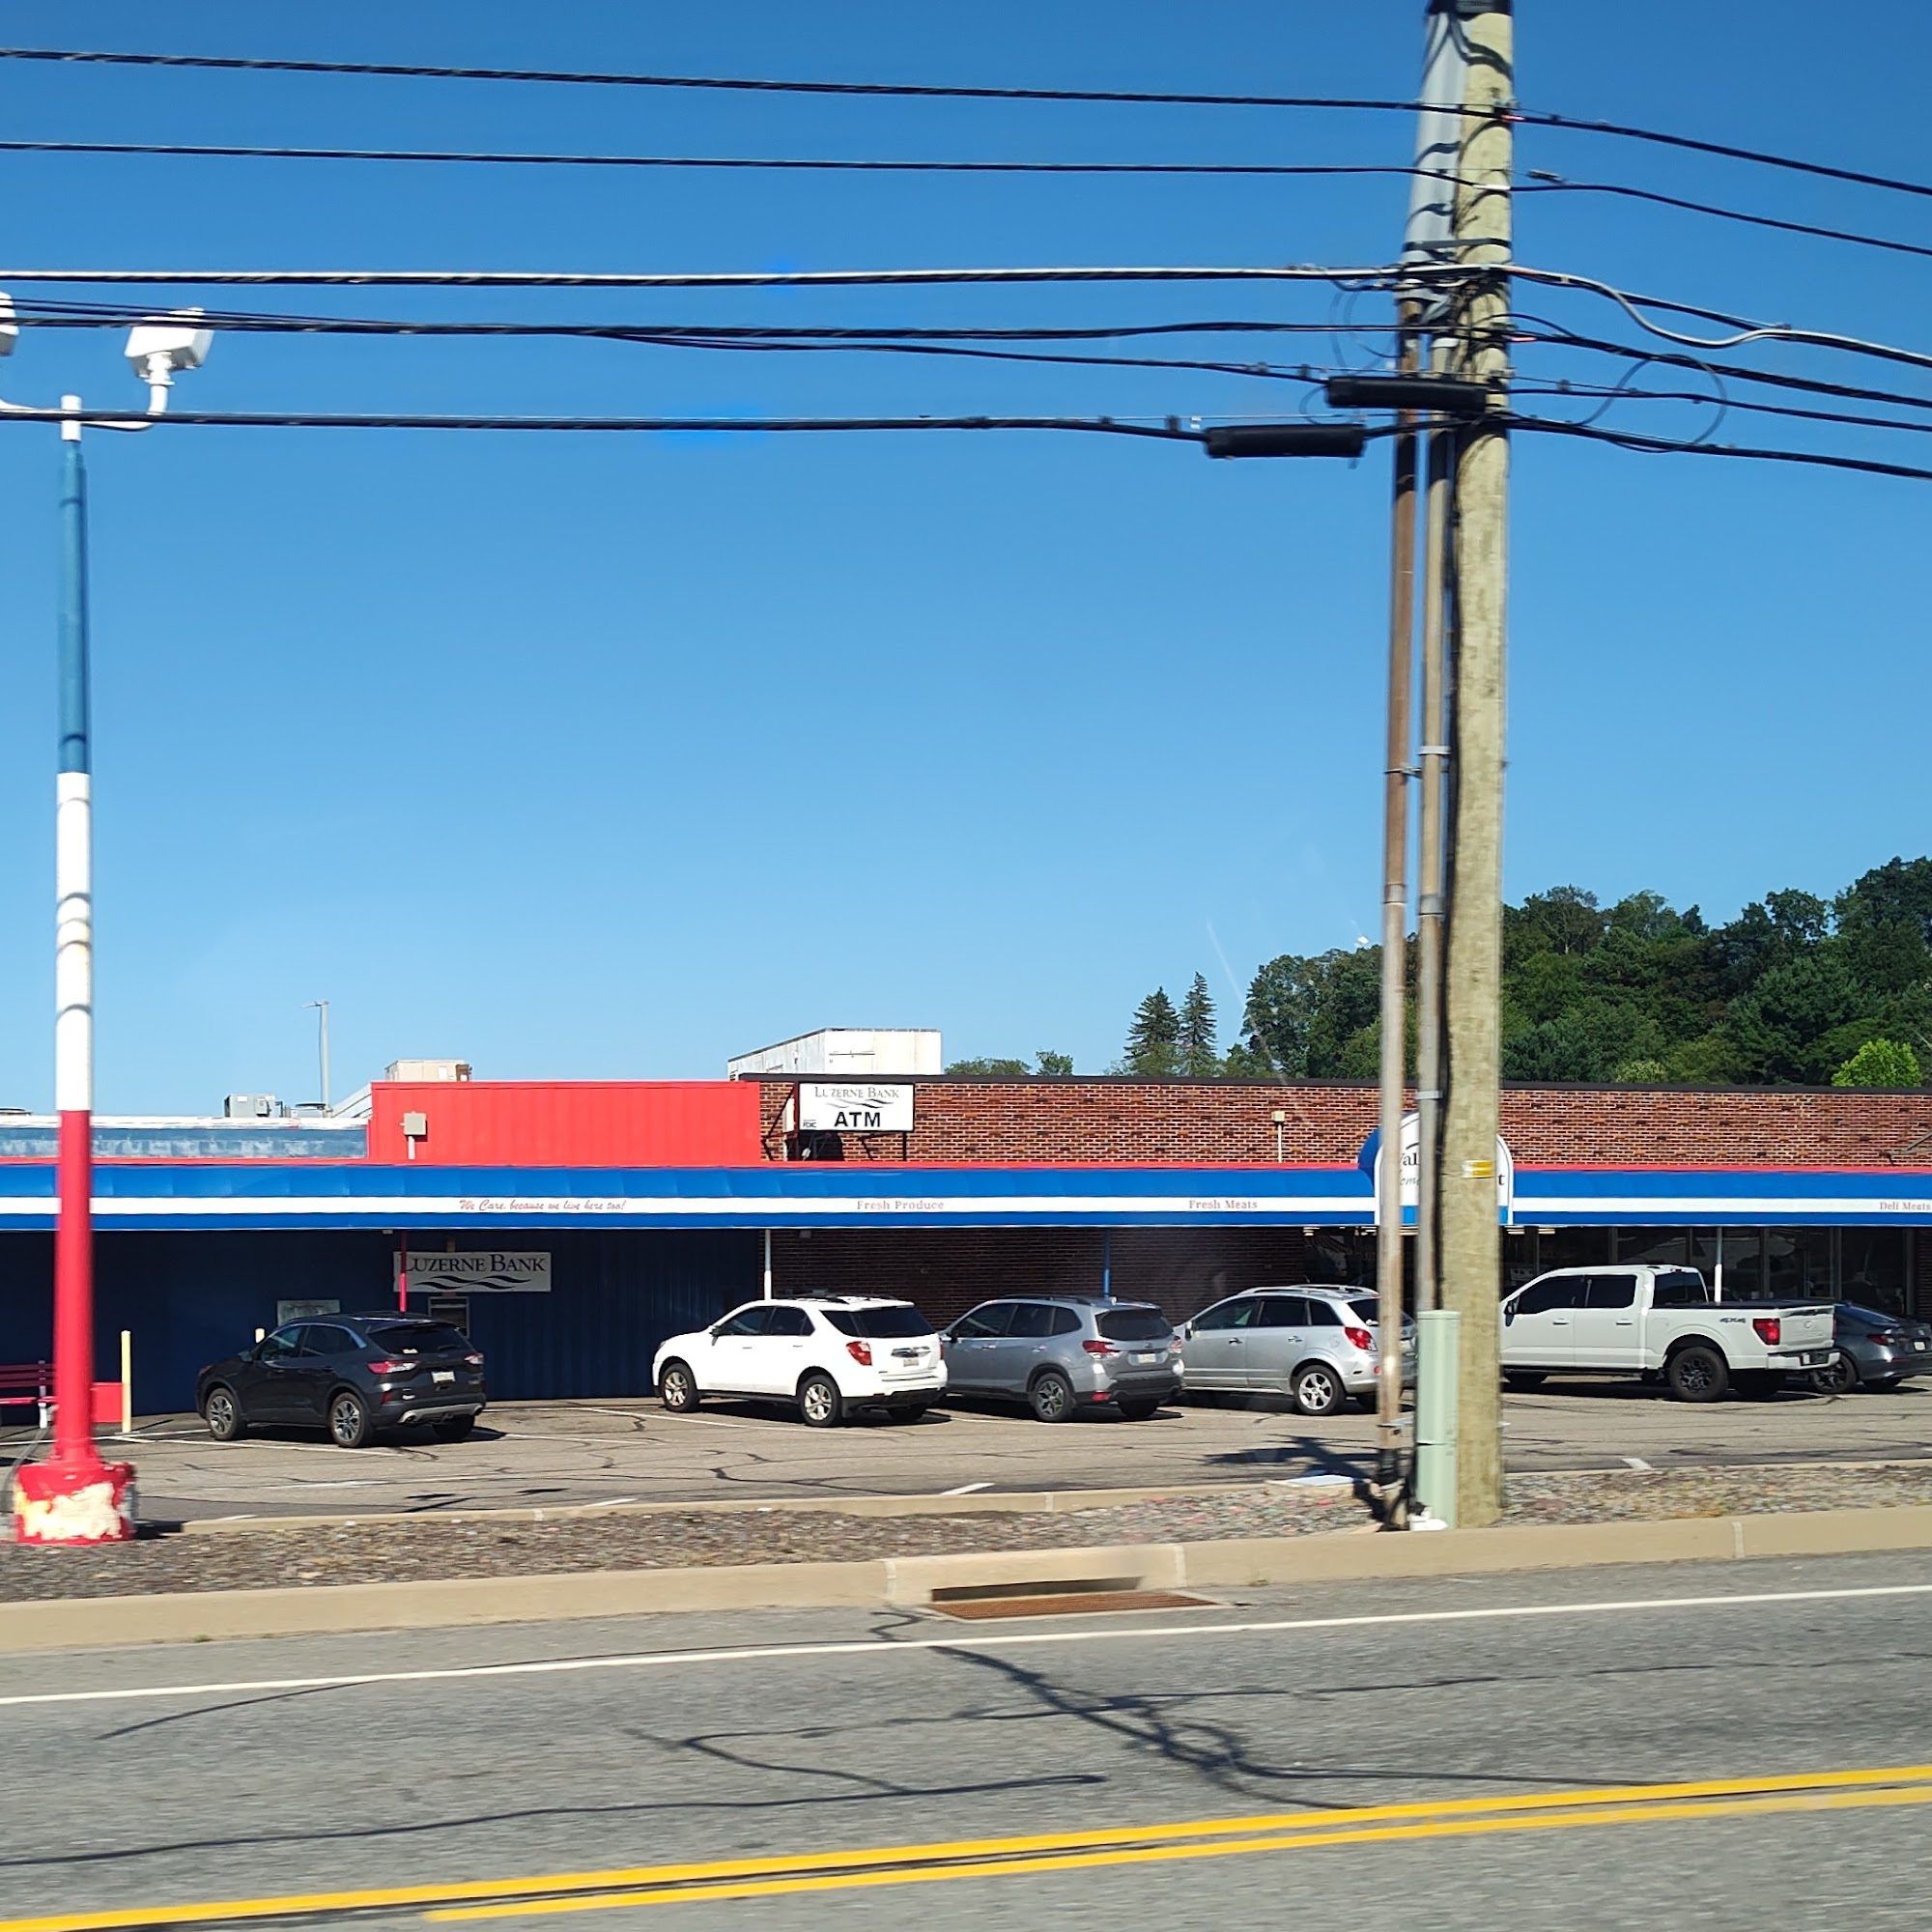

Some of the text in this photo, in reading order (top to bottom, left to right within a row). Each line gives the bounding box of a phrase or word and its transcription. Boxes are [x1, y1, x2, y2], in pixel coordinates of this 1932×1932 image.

[867, 1087, 899, 1098] BANK
[834, 1111, 881, 1127] ATM
[459, 1199, 475, 1210] We
[509, 1199, 544, 1210] because
[584, 1199, 603, 1210] here
[607, 1200, 627, 1210] too!
[857, 1201, 944, 1209] Fresh Produce
[1189, 1200, 1258, 1209] Fresh Meats
[1880, 1202, 1931, 1210] Deli Meats
[490, 1254, 546, 1272] BANK
